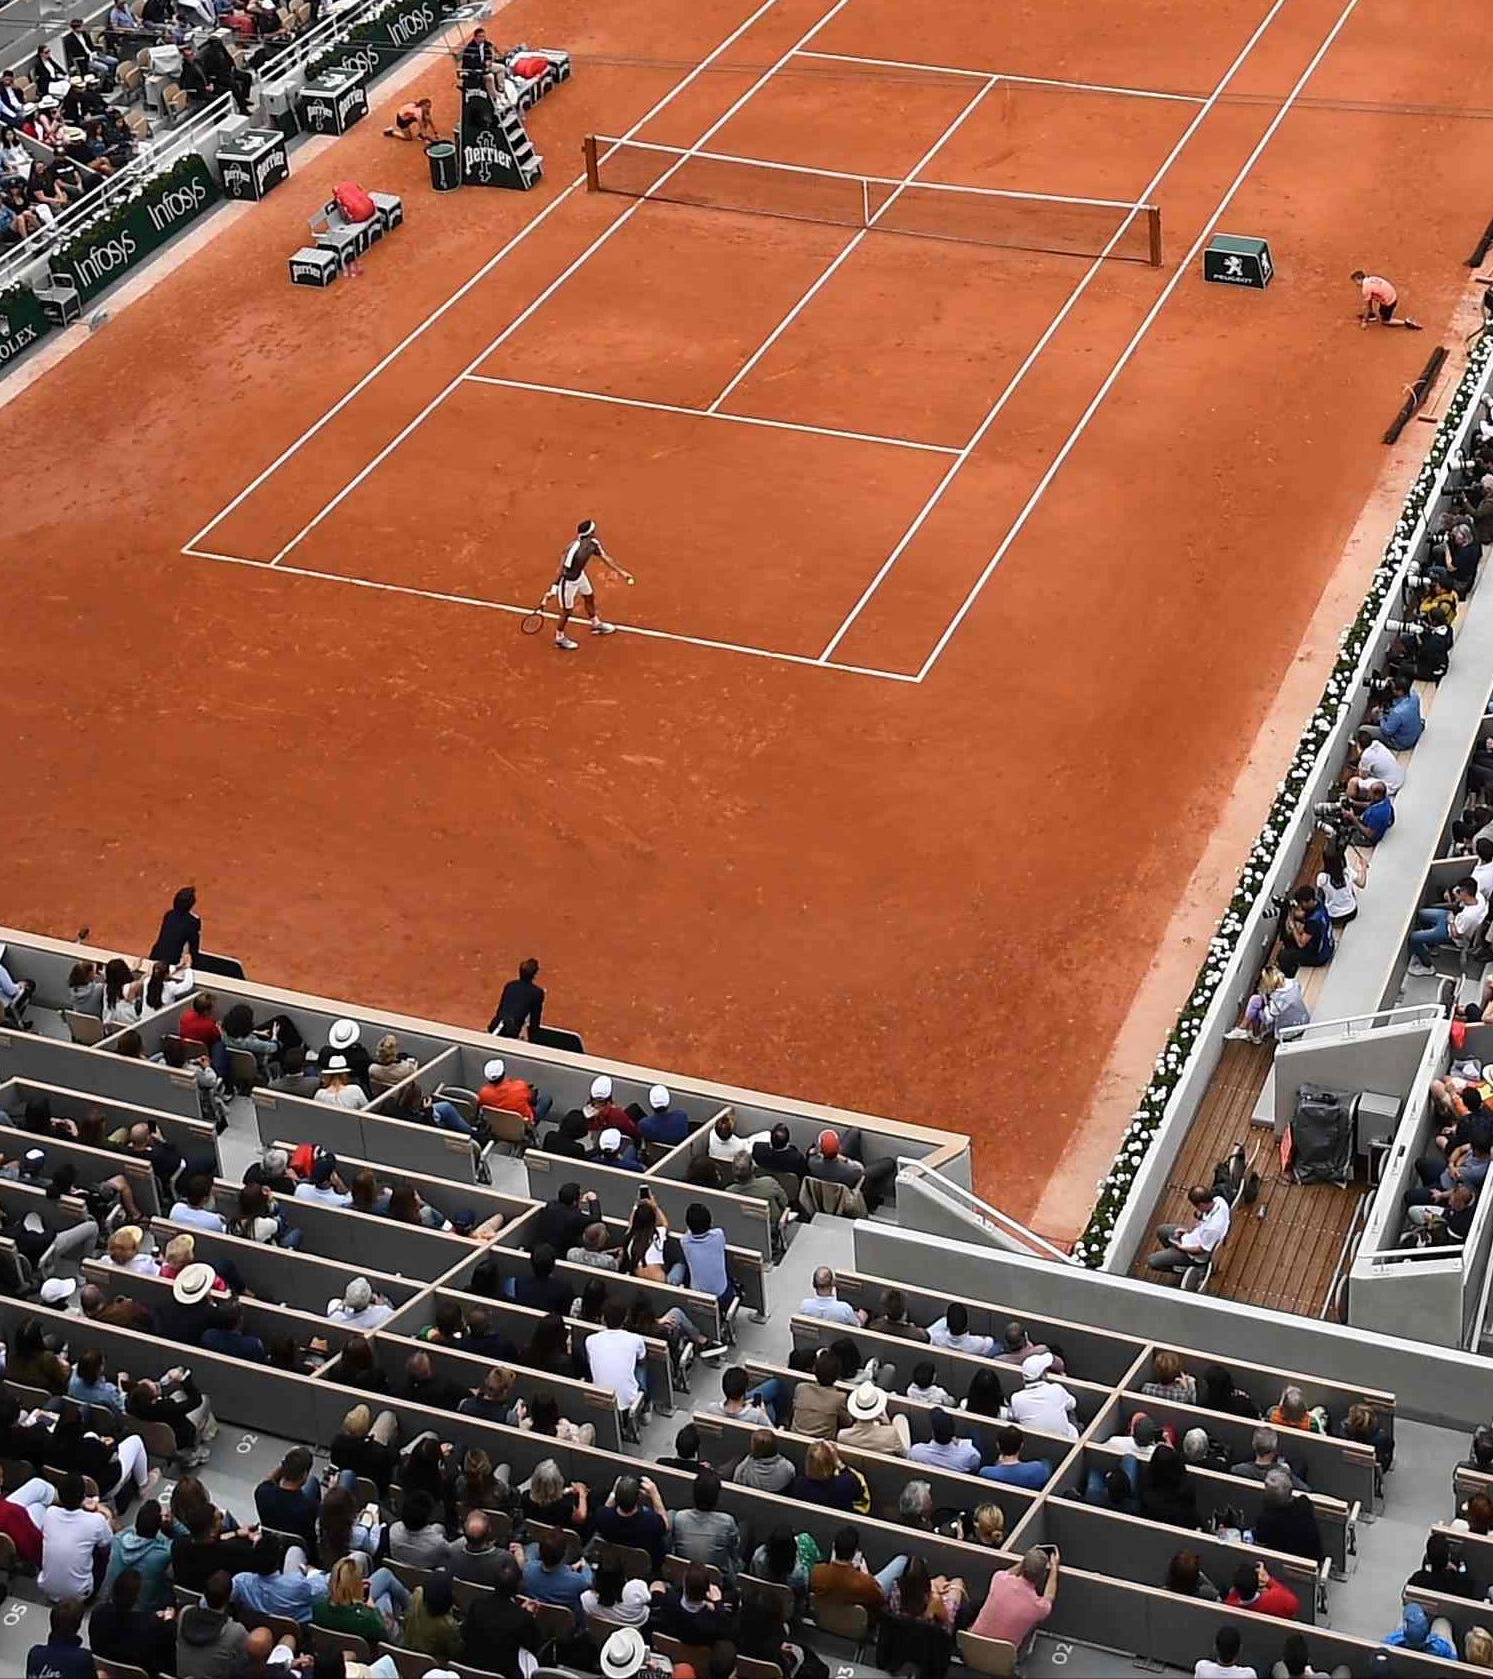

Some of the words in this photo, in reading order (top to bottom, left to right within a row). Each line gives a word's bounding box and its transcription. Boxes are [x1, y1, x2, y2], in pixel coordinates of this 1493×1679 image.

[386, 2, 434, 47] Infosys
[147, 176, 206, 232] Infosys
[74, 229, 136, 288] Infosys
[236, 1434, 259, 1454] 02
[4, 1603, 28, 1626] 05
[1052, 1642, 1074, 1665] 02
